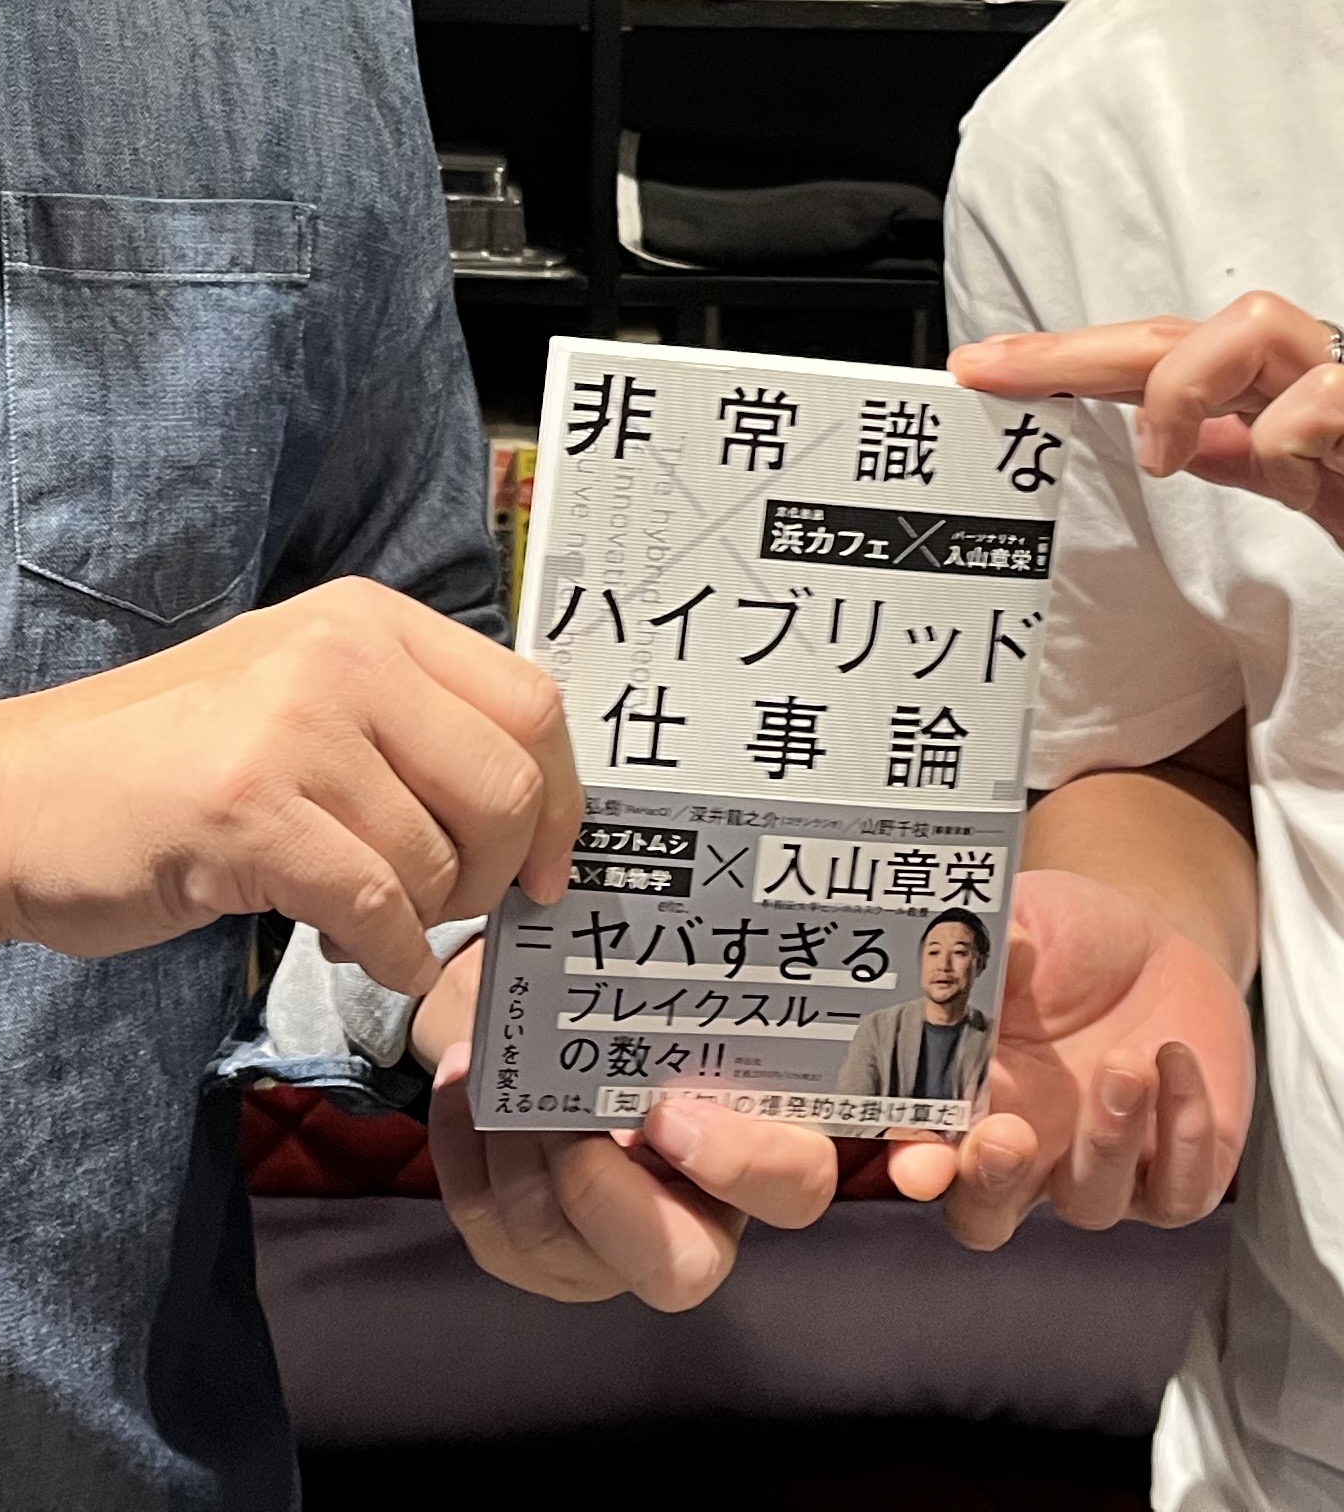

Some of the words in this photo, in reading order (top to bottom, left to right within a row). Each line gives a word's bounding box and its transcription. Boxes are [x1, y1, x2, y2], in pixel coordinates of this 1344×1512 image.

[565, 373, 1063, 492] 非常識な
[769, 521, 890, 561] 浜カフェ
[943, 544, 1032, 572] 入山章栄
[546, 584, 1044, 683] ハイブリッド
[602, 684, 969, 790] 仕事論
[763, 842, 996, 907] 入山章栄
[571, 910, 890, 985] ヤバすぎる
[567, 982, 861, 1030] ブレイクスルー
